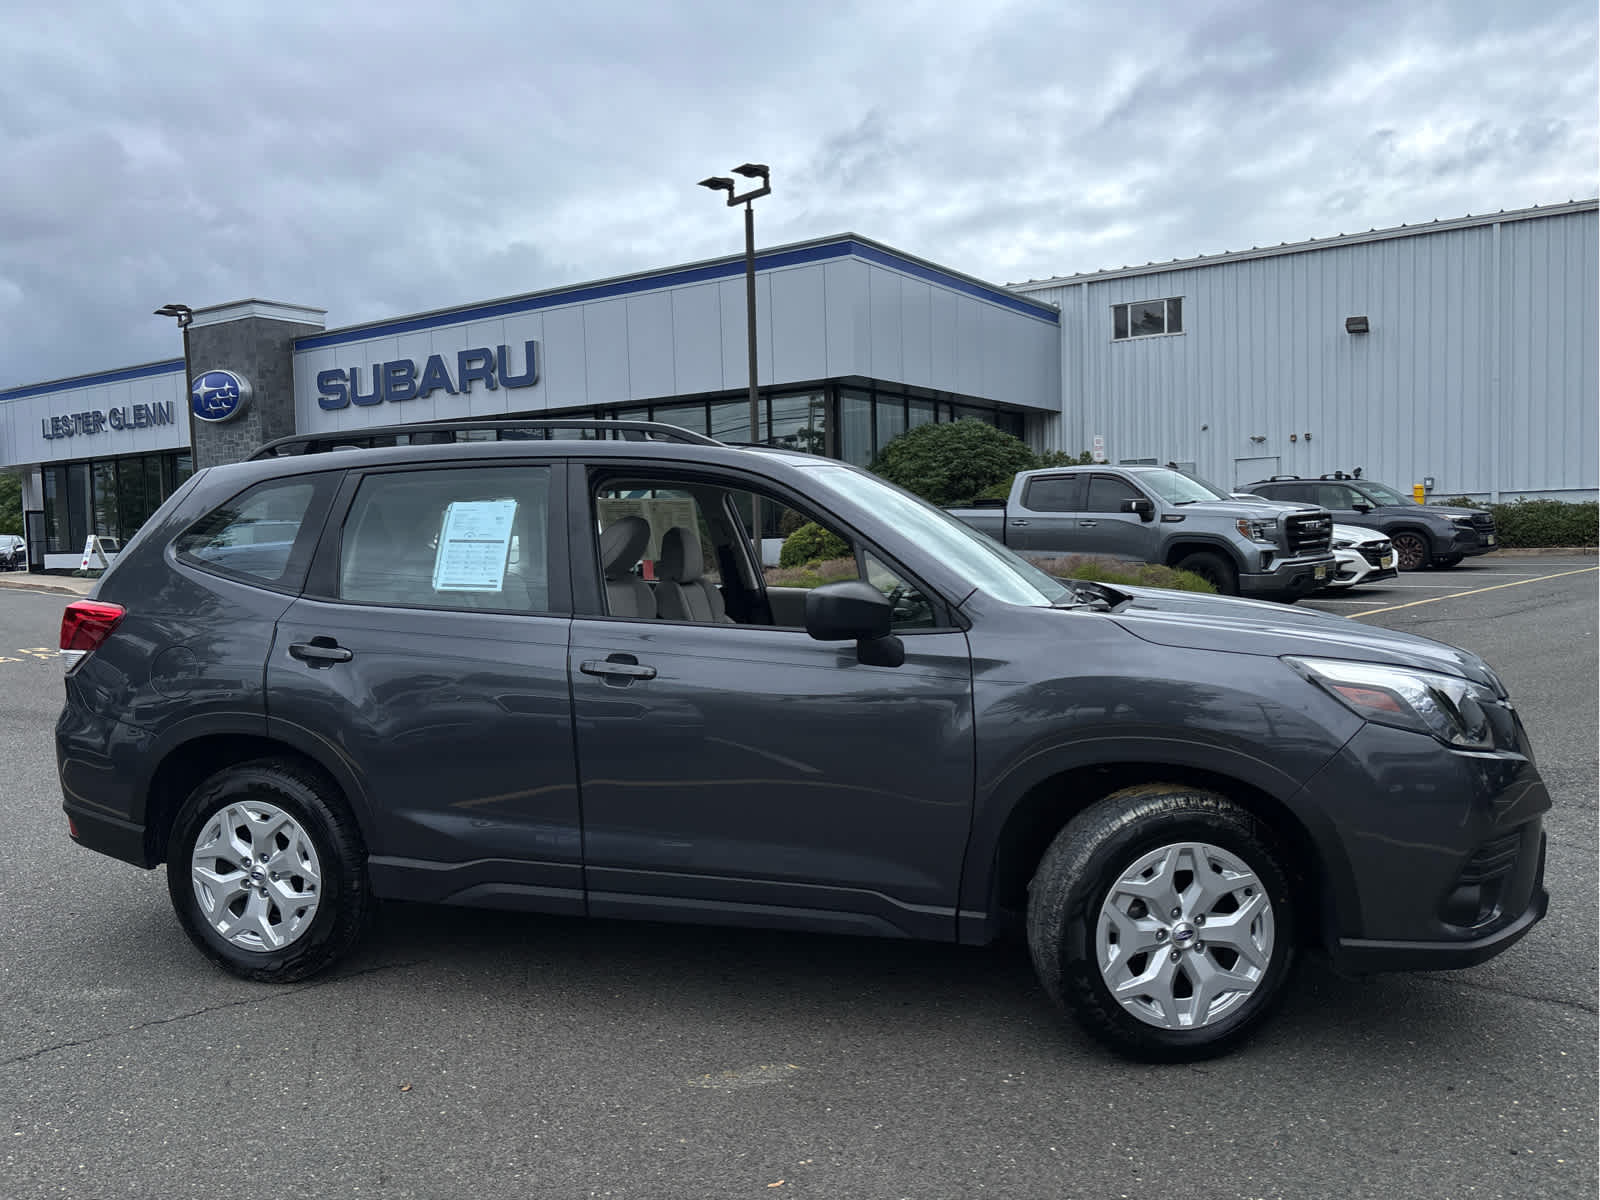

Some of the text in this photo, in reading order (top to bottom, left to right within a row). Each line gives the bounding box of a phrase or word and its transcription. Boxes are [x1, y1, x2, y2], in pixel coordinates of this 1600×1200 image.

[317, 341, 538, 410] SUBARU
[42, 401, 174, 439] LESTER GLENN
